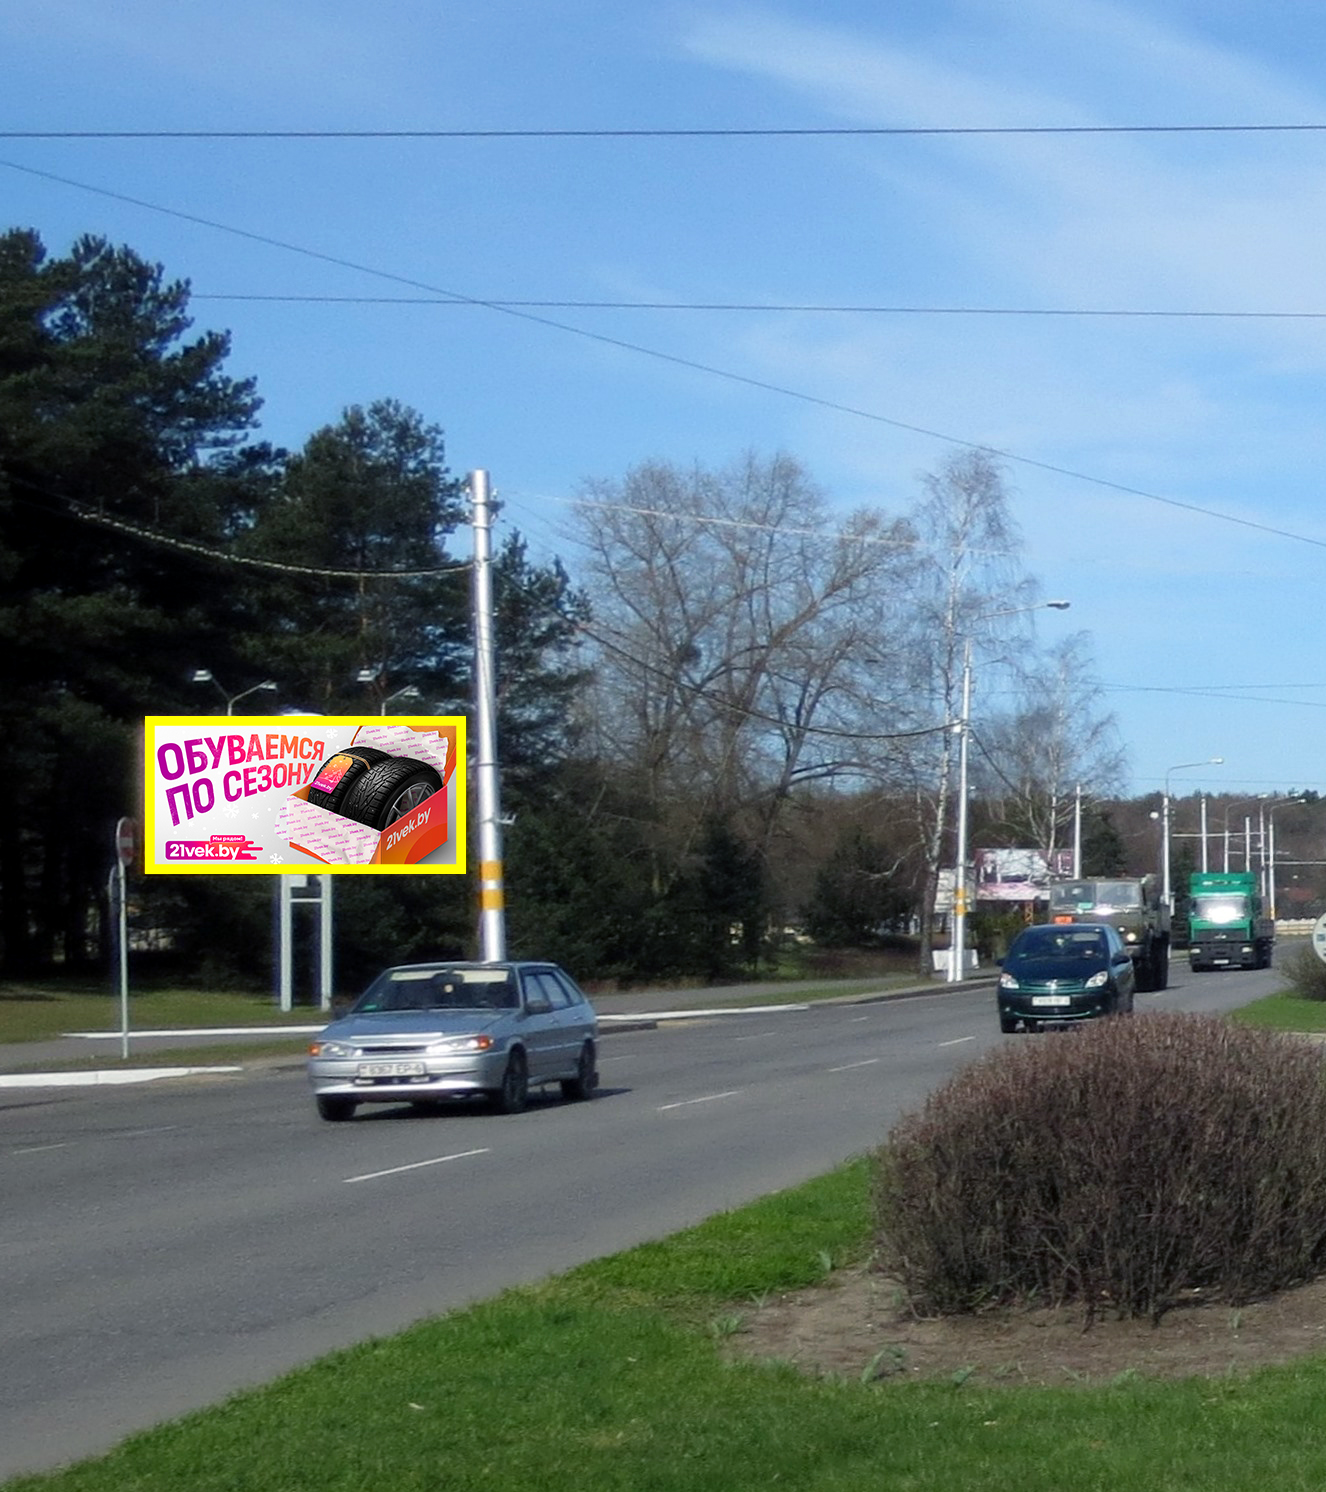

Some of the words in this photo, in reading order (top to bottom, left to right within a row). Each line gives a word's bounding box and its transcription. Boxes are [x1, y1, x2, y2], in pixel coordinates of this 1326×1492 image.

[157, 734, 325, 781] ОБУВАЕМСЯ
[165, 778, 215, 827] ПО
[223, 762, 315, 803] СЕЗОНУ
[386, 807, 432, 851] 21vek.by
[169, 843, 240, 861] 21vek.by
